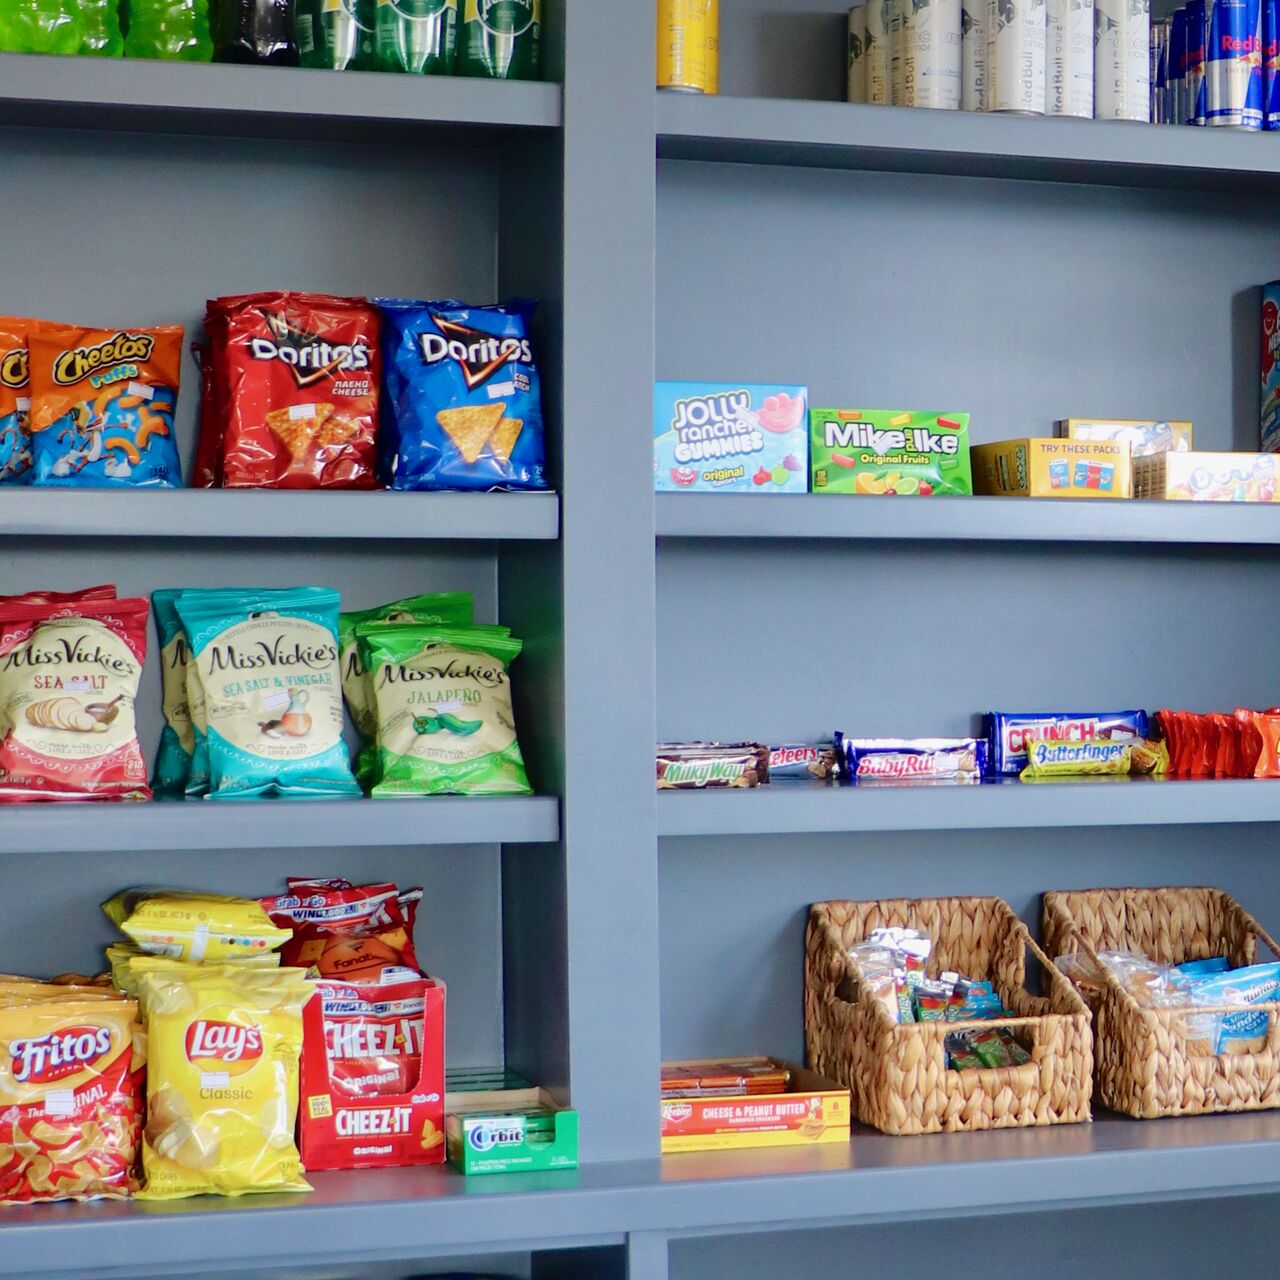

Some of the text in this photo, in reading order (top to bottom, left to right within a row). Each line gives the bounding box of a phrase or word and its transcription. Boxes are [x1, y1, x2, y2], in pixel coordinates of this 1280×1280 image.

[1222, 35, 1253, 51] Red
[54, 332, 154, 385] Cheetos
[252, 338, 368, 368] Doritos
[422, 333, 532, 363] Doritos
[332, 388, 368, 396] CHEESE
[675, 393, 747, 428] JOLLY
[675, 431, 764, 463] GUMMIES
[825, 422, 906, 449] Mike
[913, 430, 959, 453] Ike
[861, 454, 930, 465] Original Fruits
[1041, 445, 1121, 454] TRY THESE PACKS
[703, 466, 744, 481] original
[34, 675, 64, 689] SEA
[223, 673, 332, 698] SEA SALT & VINEGAR
[1036, 743, 1124, 764] Butterfinger
[276, 896, 300, 907] Grab
[191, 1020, 260, 1061] Lay's
[9, 1028, 111, 1082] Fritos
[200, 1087, 253, 1101] Classic
[28, 1108, 45, 1118] The
[335, 1108, 412, 1135] CHEEZ-IT
[664, 1107, 692, 1118] Keebler
[703, 1107, 733, 1119] CHEESE
[744, 1105, 773, 1117] PEANUT
[775, 1103, 805, 1116] BUTTER
[470, 1125, 523, 1151] Orbit
